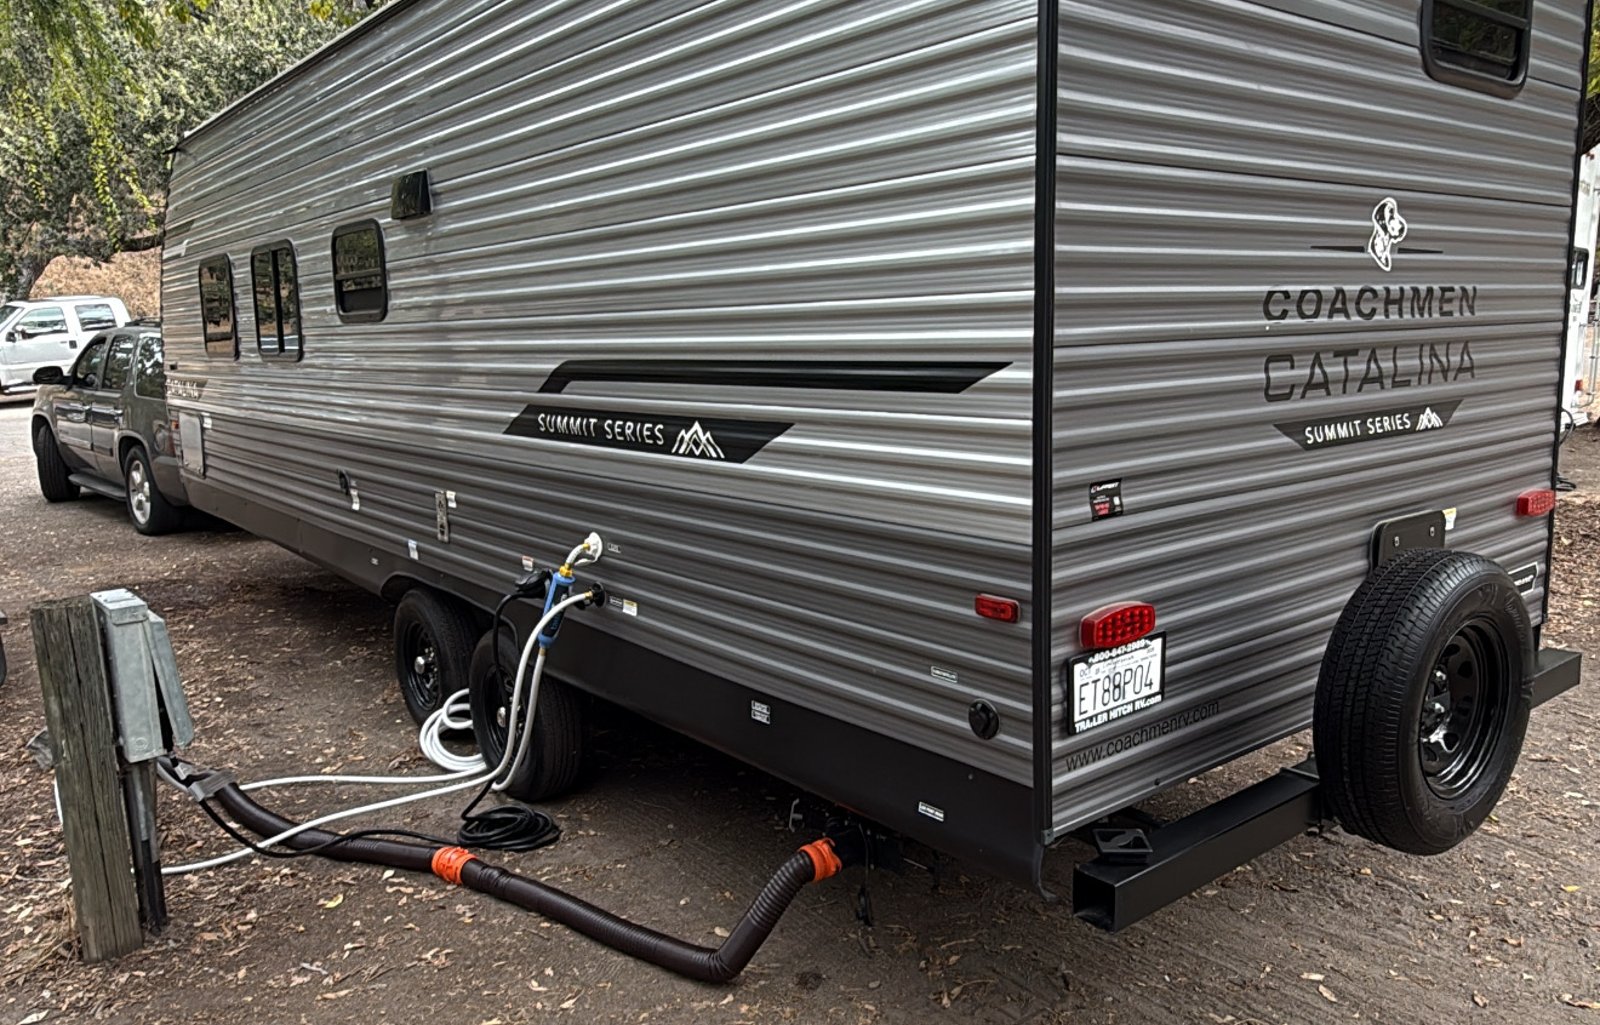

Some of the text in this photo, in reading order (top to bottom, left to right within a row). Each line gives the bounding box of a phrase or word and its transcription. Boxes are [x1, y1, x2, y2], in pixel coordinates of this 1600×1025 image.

[1263, 285, 1478, 322] COACHMEN
[1263, 340, 1475, 402] CATALINA
[538, 413, 664, 445] SUMMIT SERIES
[1305, 413, 1411, 444] SUMMIT SERIES
[1078, 661, 1153, 716] ET88P04
[1066, 701, 1220, 773] www.coachmenrv.com
